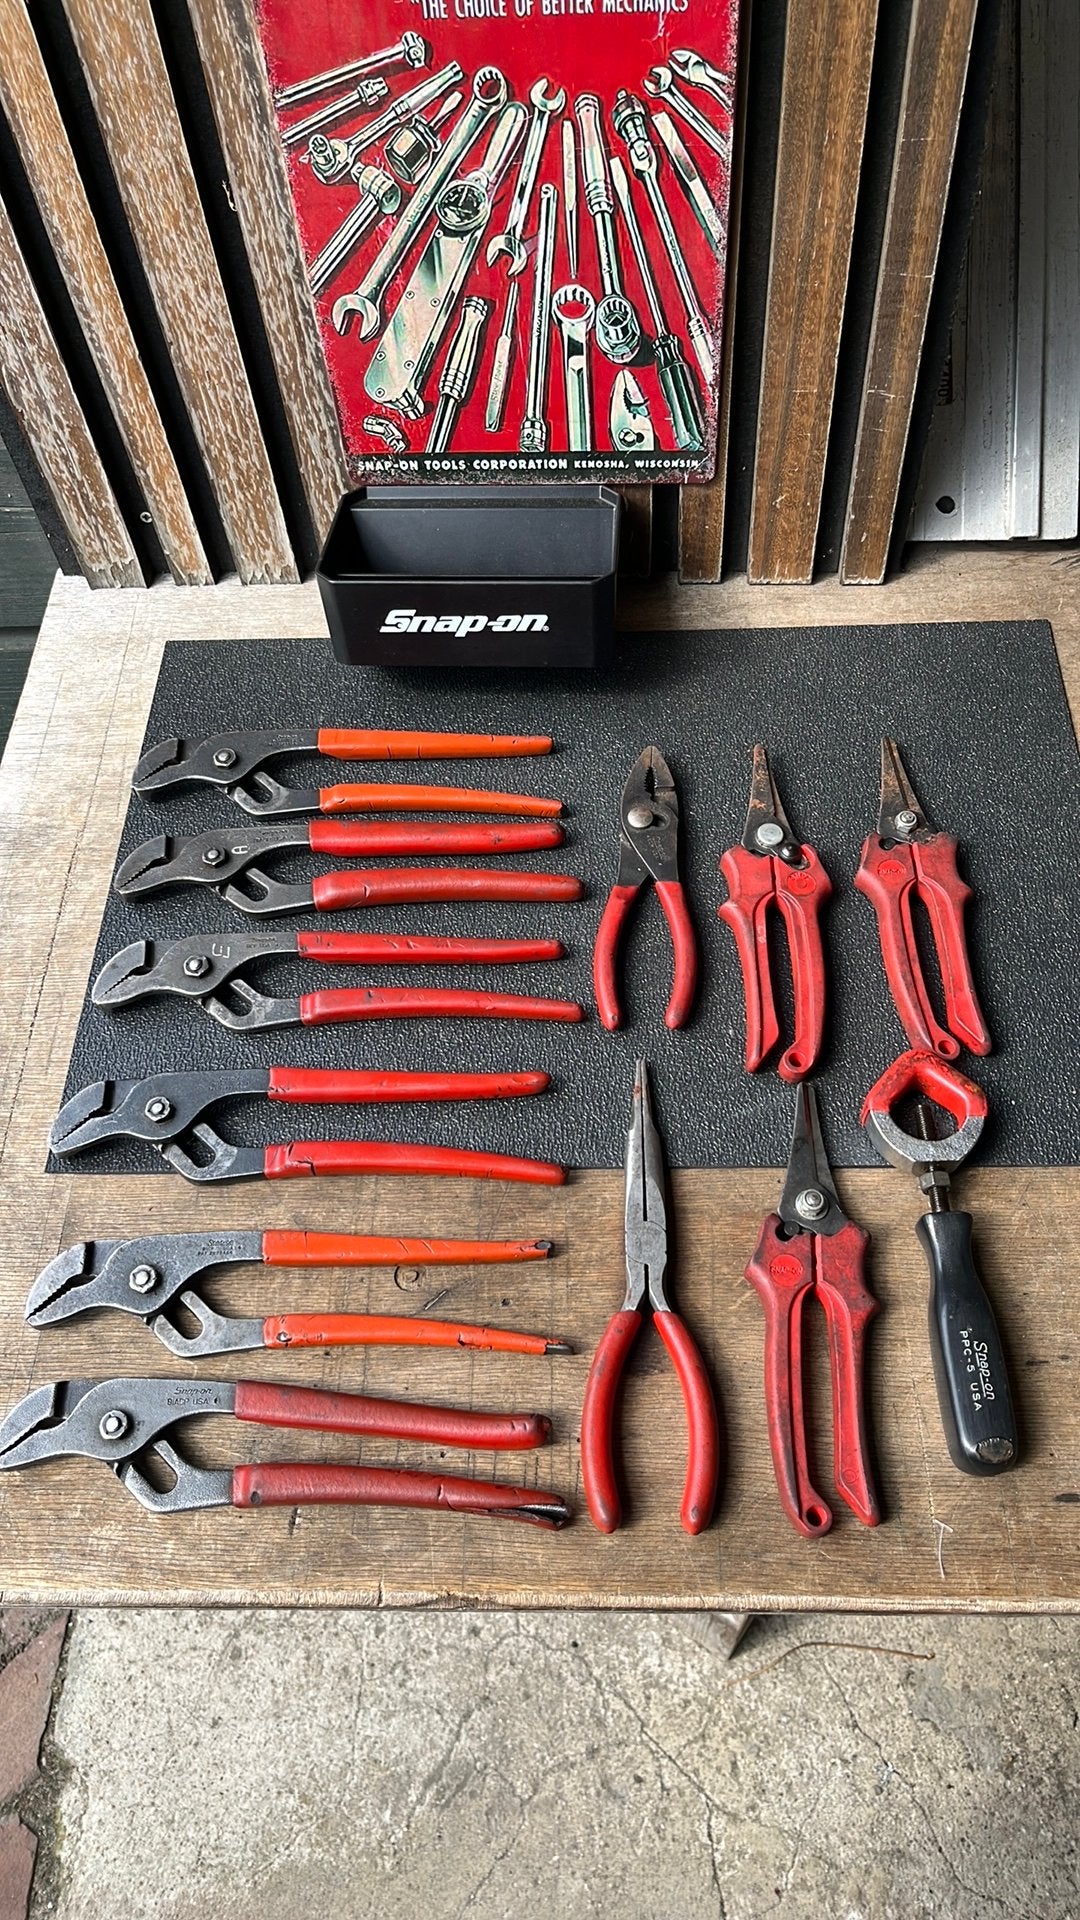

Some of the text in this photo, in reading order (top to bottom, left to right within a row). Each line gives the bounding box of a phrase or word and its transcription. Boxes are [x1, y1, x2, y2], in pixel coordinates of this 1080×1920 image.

[455, 0, 507, 18] CHOICE
[515, 0, 534, 17] OF
[542, 0, 594, 15] BETTER
[602, 0, 689, 13] MECHANICS
[358, 459, 699, 471] SNAP-ON TOOLS CORPORATION KENOSHA, WISCONSIN
[380, 609, 549, 637] Snap-on
[960, 1330, 982, 1411] PPC-5 USA
[973, 1341, 996, 1400] Snap-on
[173, 1386, 214, 1397] Snap-on
[193, 1397, 209, 1405] USA
